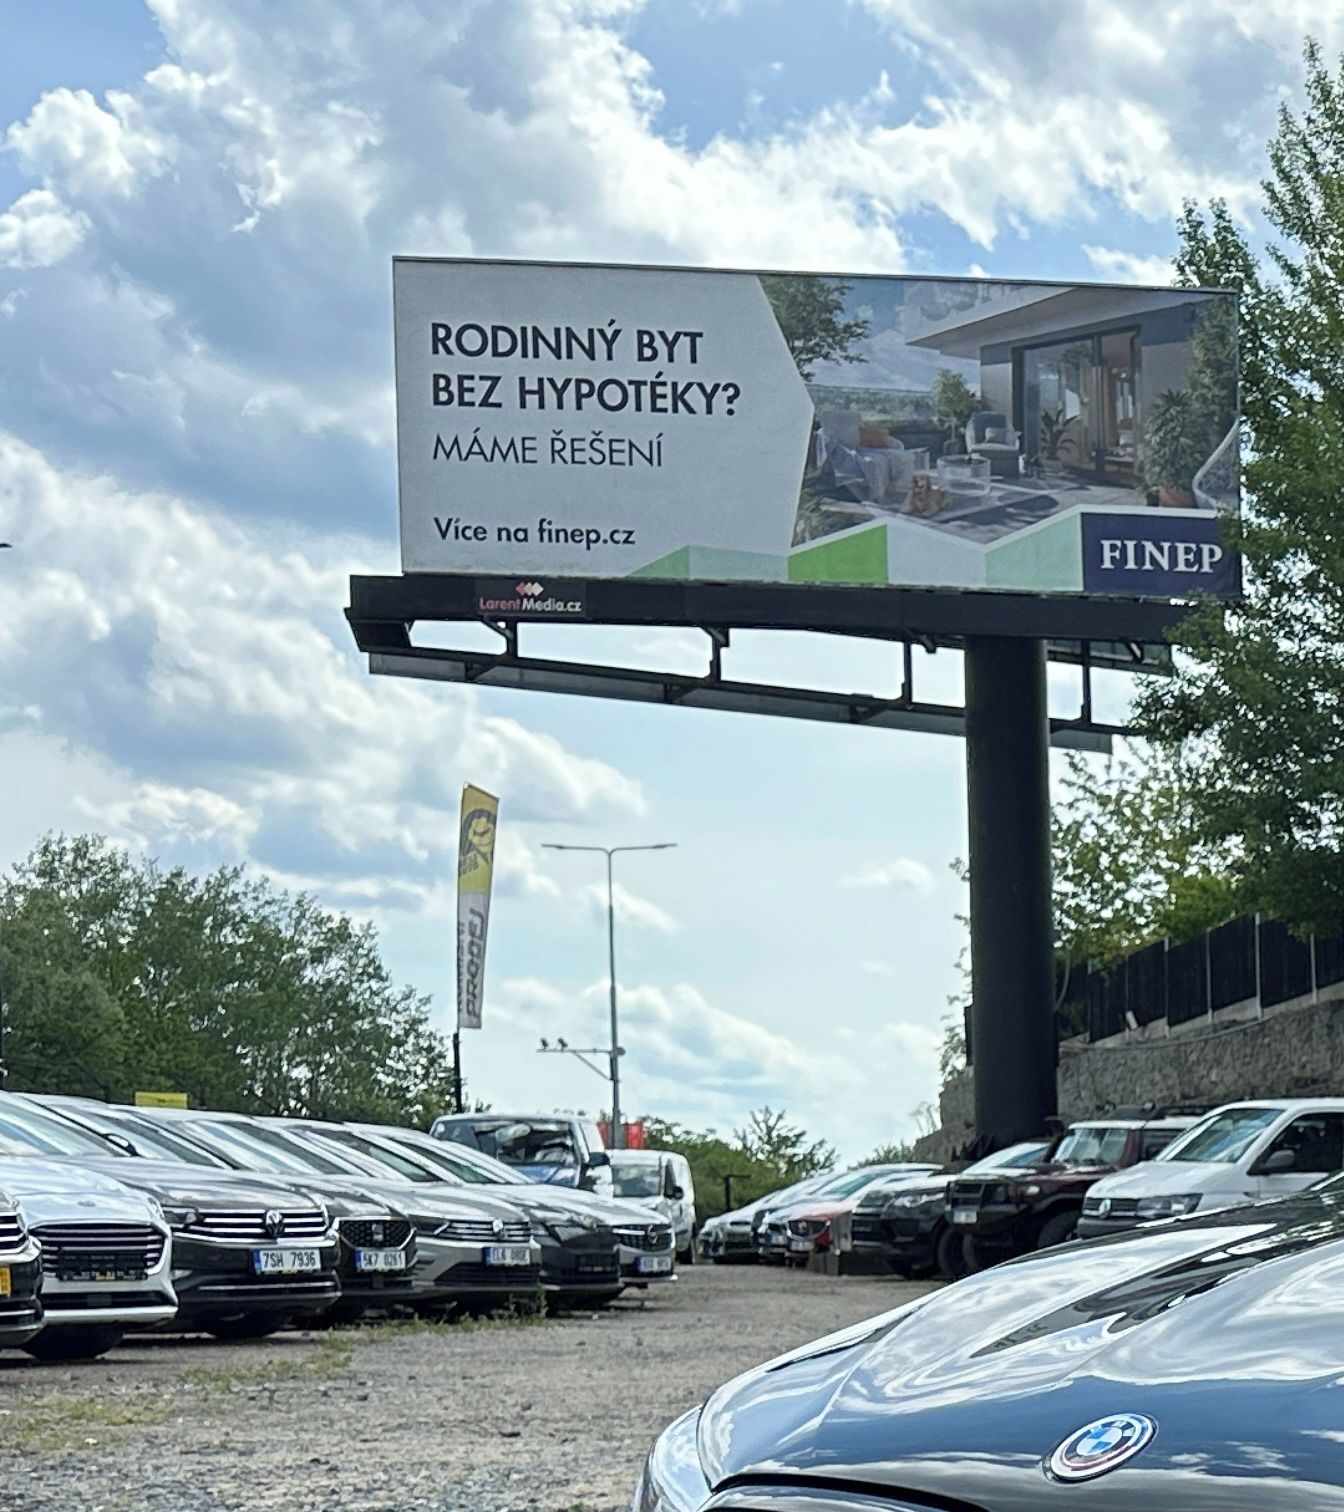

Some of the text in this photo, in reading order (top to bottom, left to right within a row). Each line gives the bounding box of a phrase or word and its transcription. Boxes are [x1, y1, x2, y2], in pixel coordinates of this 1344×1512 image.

[430, 319, 704, 365] RODINNÝ BYT
[432, 371, 741, 417] BEZ HYPOTÉKY?
[432, 427, 664, 468] MÁME ŘEŠENÍ
[434, 517, 637, 551] Více na finep.cz
[1100, 540, 1223, 573] FINEP
[479, 597, 582, 612] LarentMedia.cz
